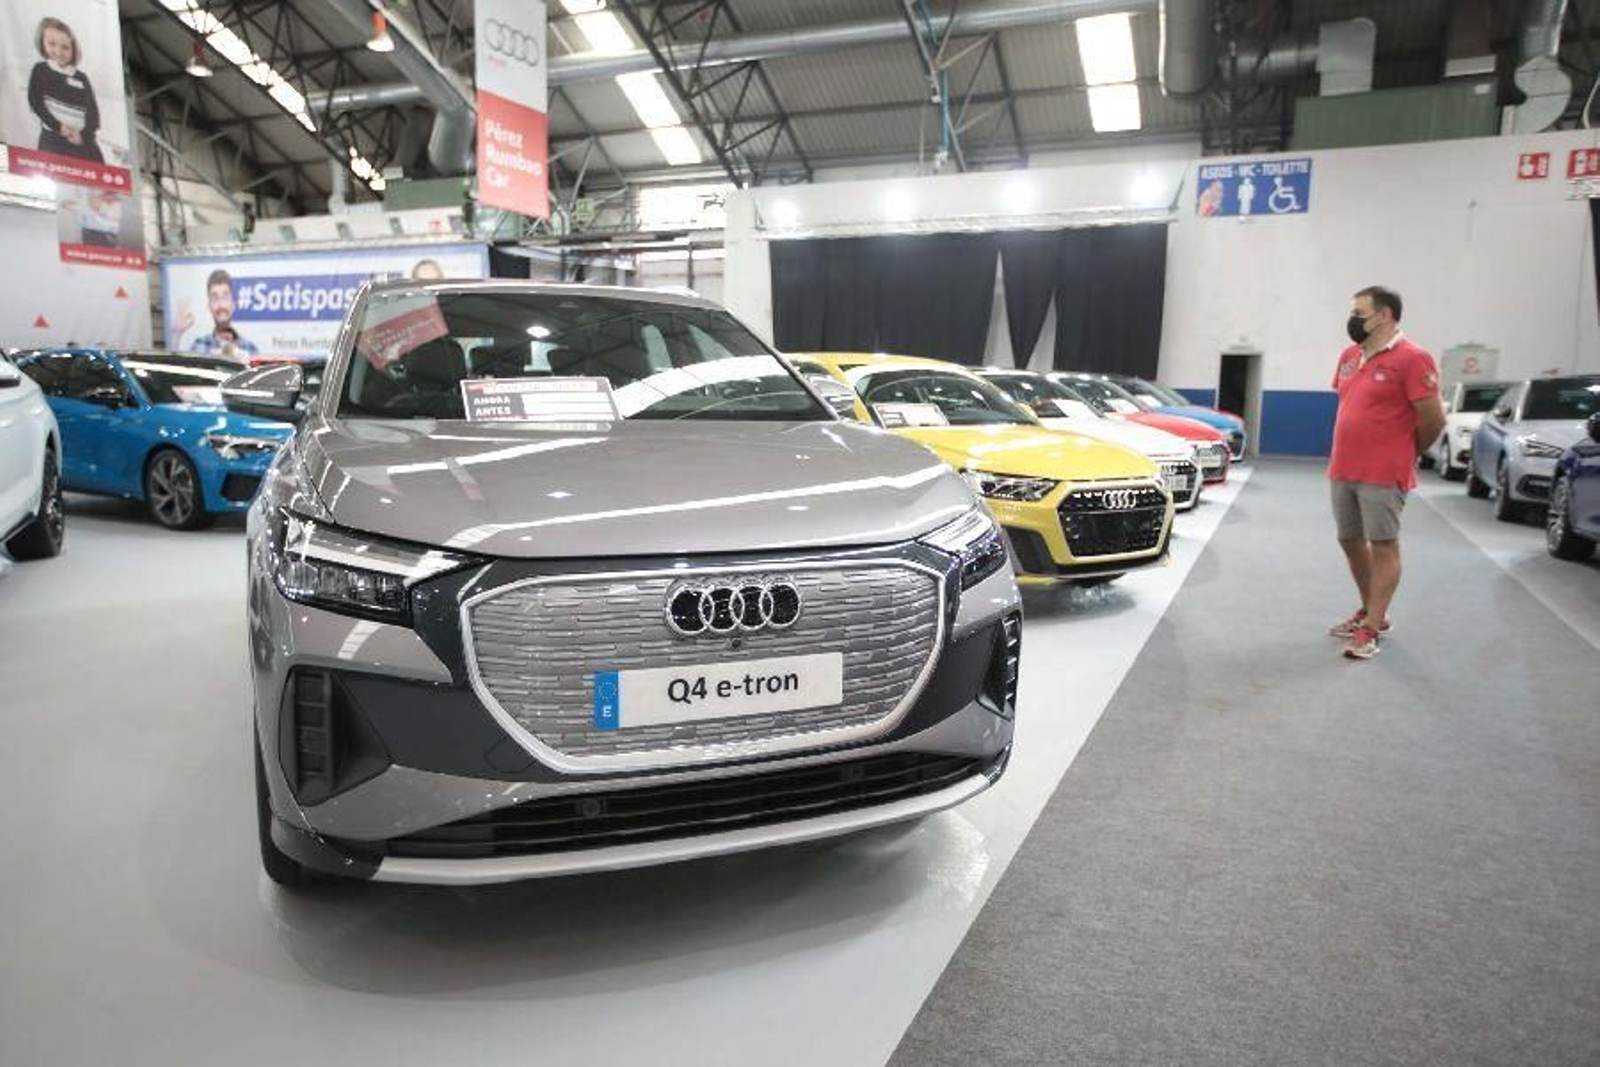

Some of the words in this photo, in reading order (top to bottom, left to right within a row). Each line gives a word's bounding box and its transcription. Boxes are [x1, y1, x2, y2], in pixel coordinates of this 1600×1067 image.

[484, 166, 511, 188] Car
[238, 281, 358, 318] #Satispas
[475, 406, 512, 417] ANTES
[667, 677, 708, 704] Q4
[717, 672, 799, 698] e-tron
[602, 706, 612, 717] E
